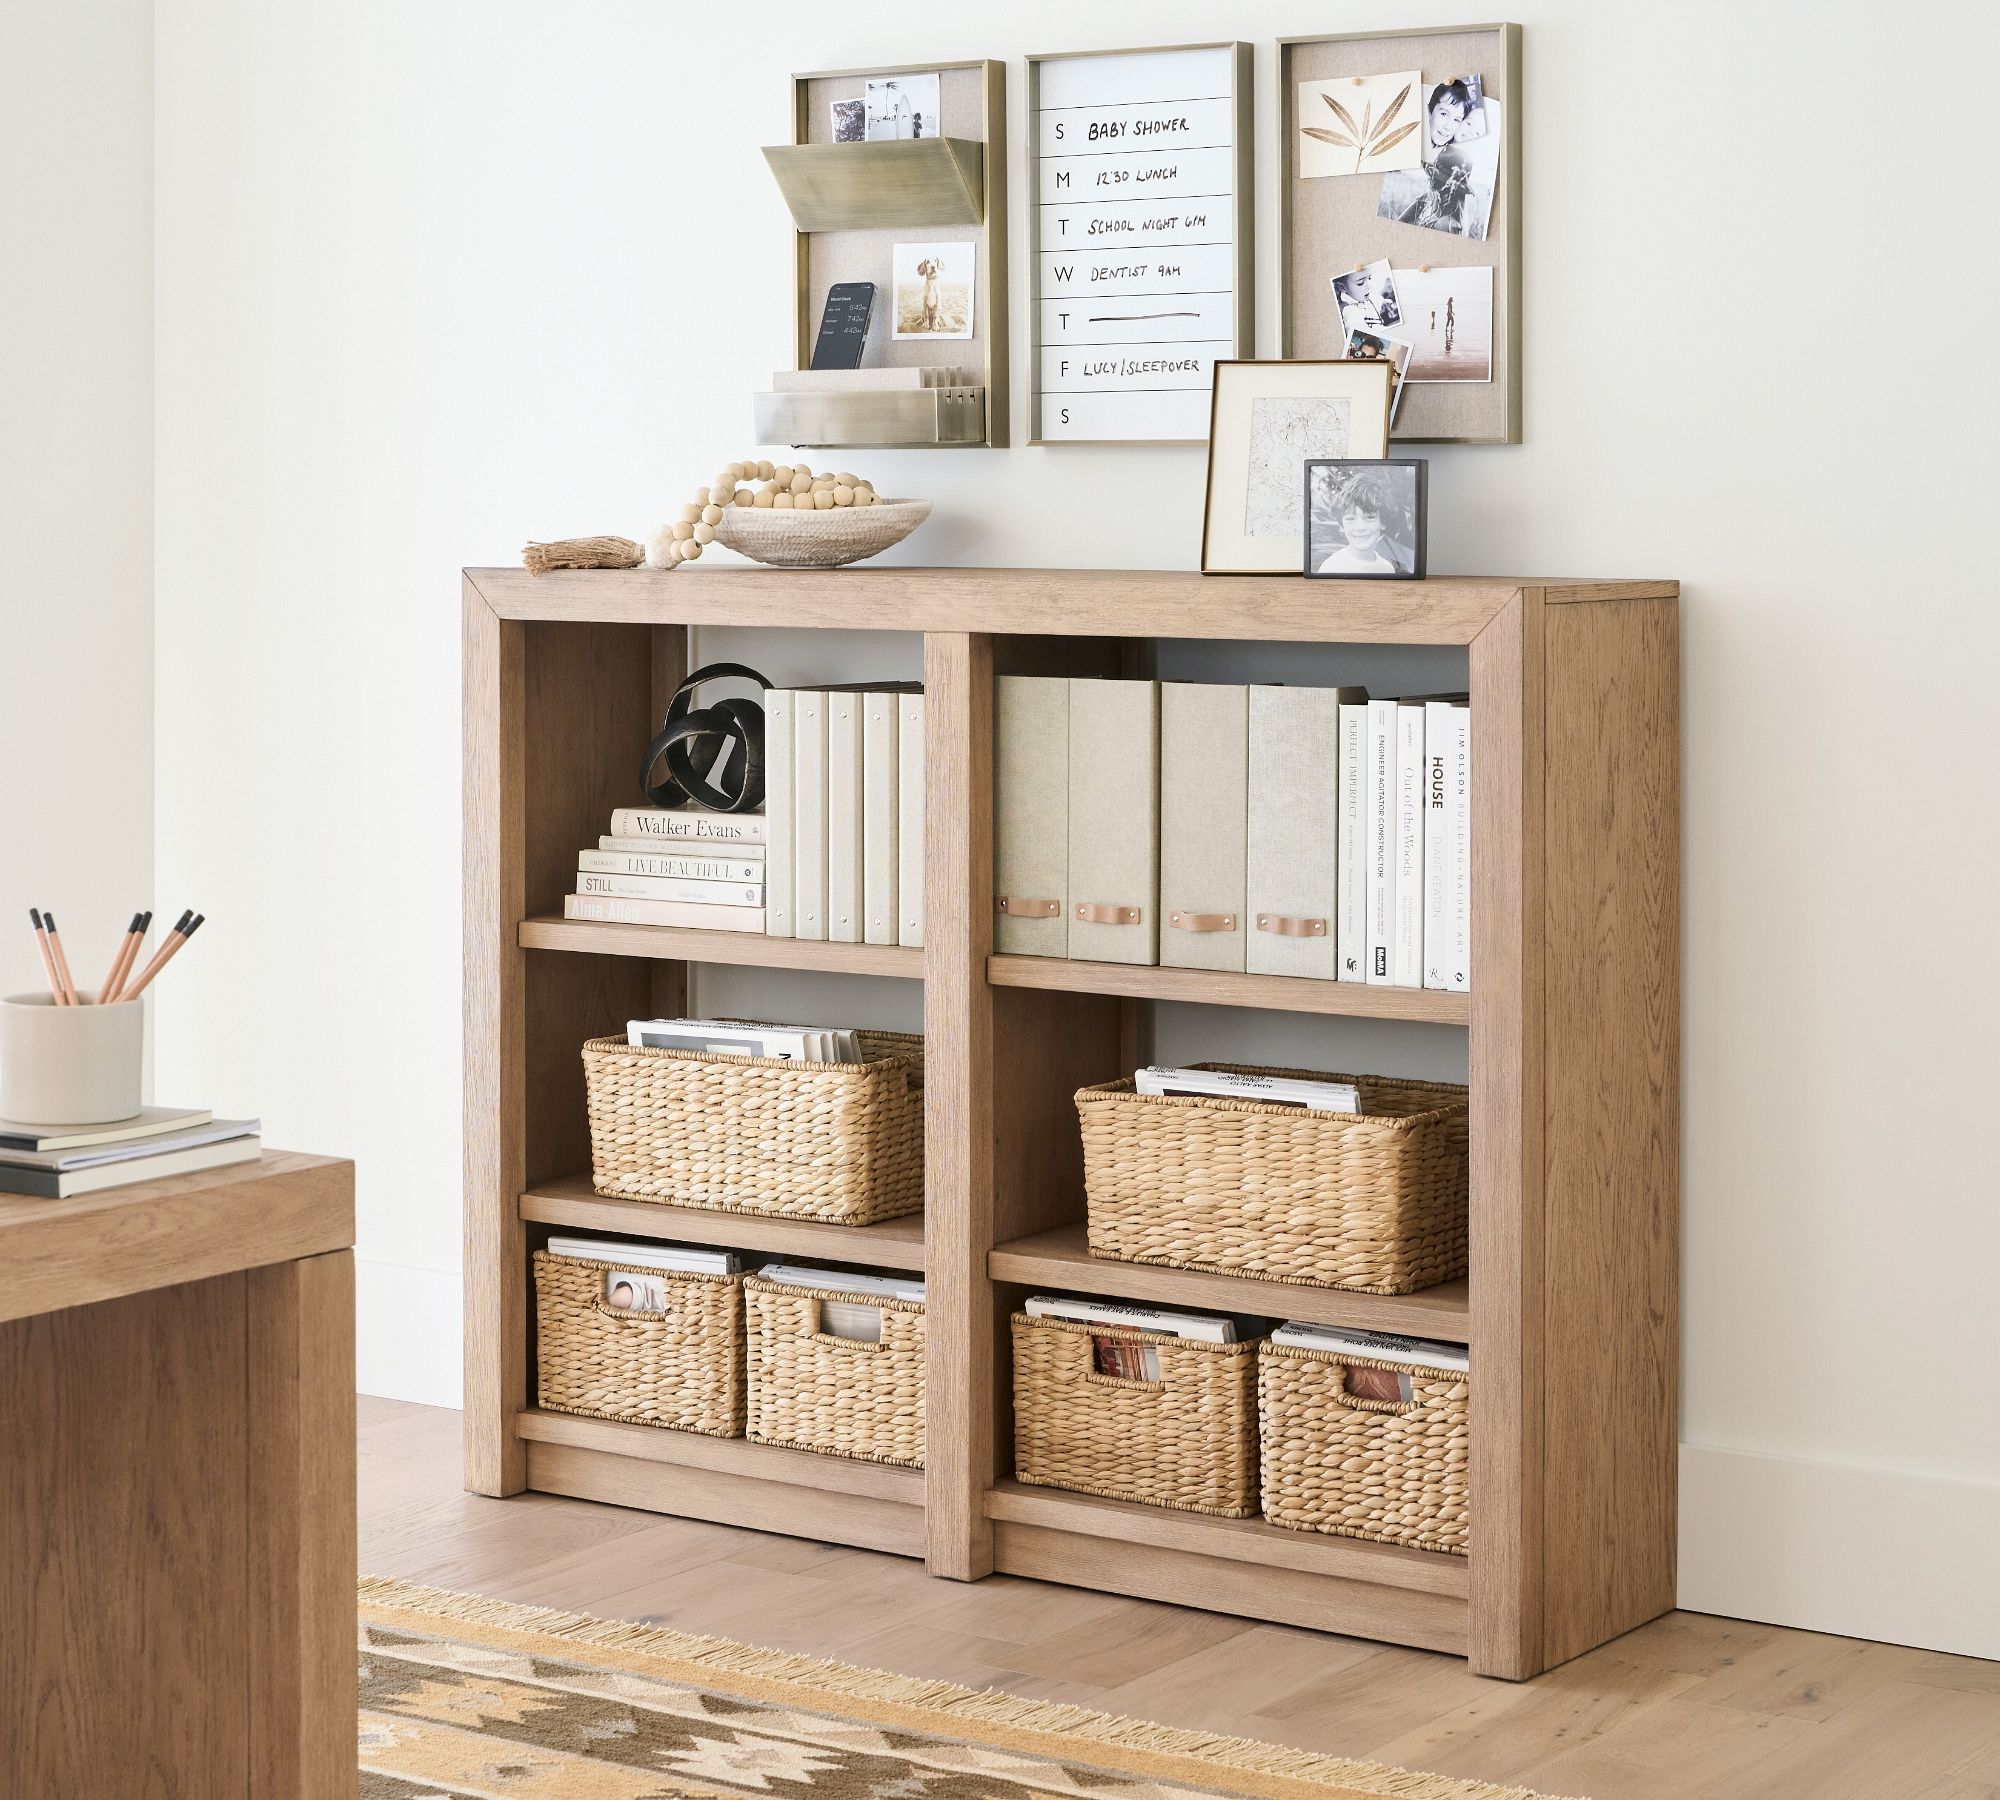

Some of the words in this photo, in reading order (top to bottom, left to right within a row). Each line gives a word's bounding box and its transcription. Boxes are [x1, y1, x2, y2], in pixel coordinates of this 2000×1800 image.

[1056, 124, 1064, 140] S
[1088, 121, 1128, 141] BABY
[1133, 118, 1190, 136] SHOWER
[1056, 172, 1070, 188] M
[1136, 166, 1178, 182] LUNCH
[1058, 219, 1070, 236] T
[1087, 219, 1135, 236] SCHOOL
[1142, 217, 1179, 231] NIGHT
[1054, 266, 1074, 282] W
[1091, 265, 1148, 282] DENTIST
[1157, 265, 1181, 277] 9AM
[1058, 313, 1070, 330] T
[1061, 361, 1069, 378] F
[1060, 408, 1070, 424] S
[1349, 720, 1358, 761] PERFECT
[1404, 767, 1415, 790] Out
[1432, 756, 1444, 809] HOUSE
[1348, 766, 1357, 820] IMPERFECT
[1404, 795, 1414, 809] of
[636, 816, 691, 836] Walker
[696, 819, 742, 839] Evans
[1404, 812, 1414, 832] the
[1377, 817, 1385, 878] CONSTRUCTOR
[1403, 833, 1414, 877] Woods
[1432, 836, 1442, 871] DIANE
[627, 858, 657, 874] LIVE
[659, 859, 734, 879] BEAUTIFUL
[585, 877, 614, 893] STILL
[1432, 874, 1442, 919] KEATON
[570, 898, 602, 918] Alma
[607, 900, 640, 921] Allen
[1377, 948, 1385, 975] MoMA
[1400, 1338, 1420, 1346] JOHN
